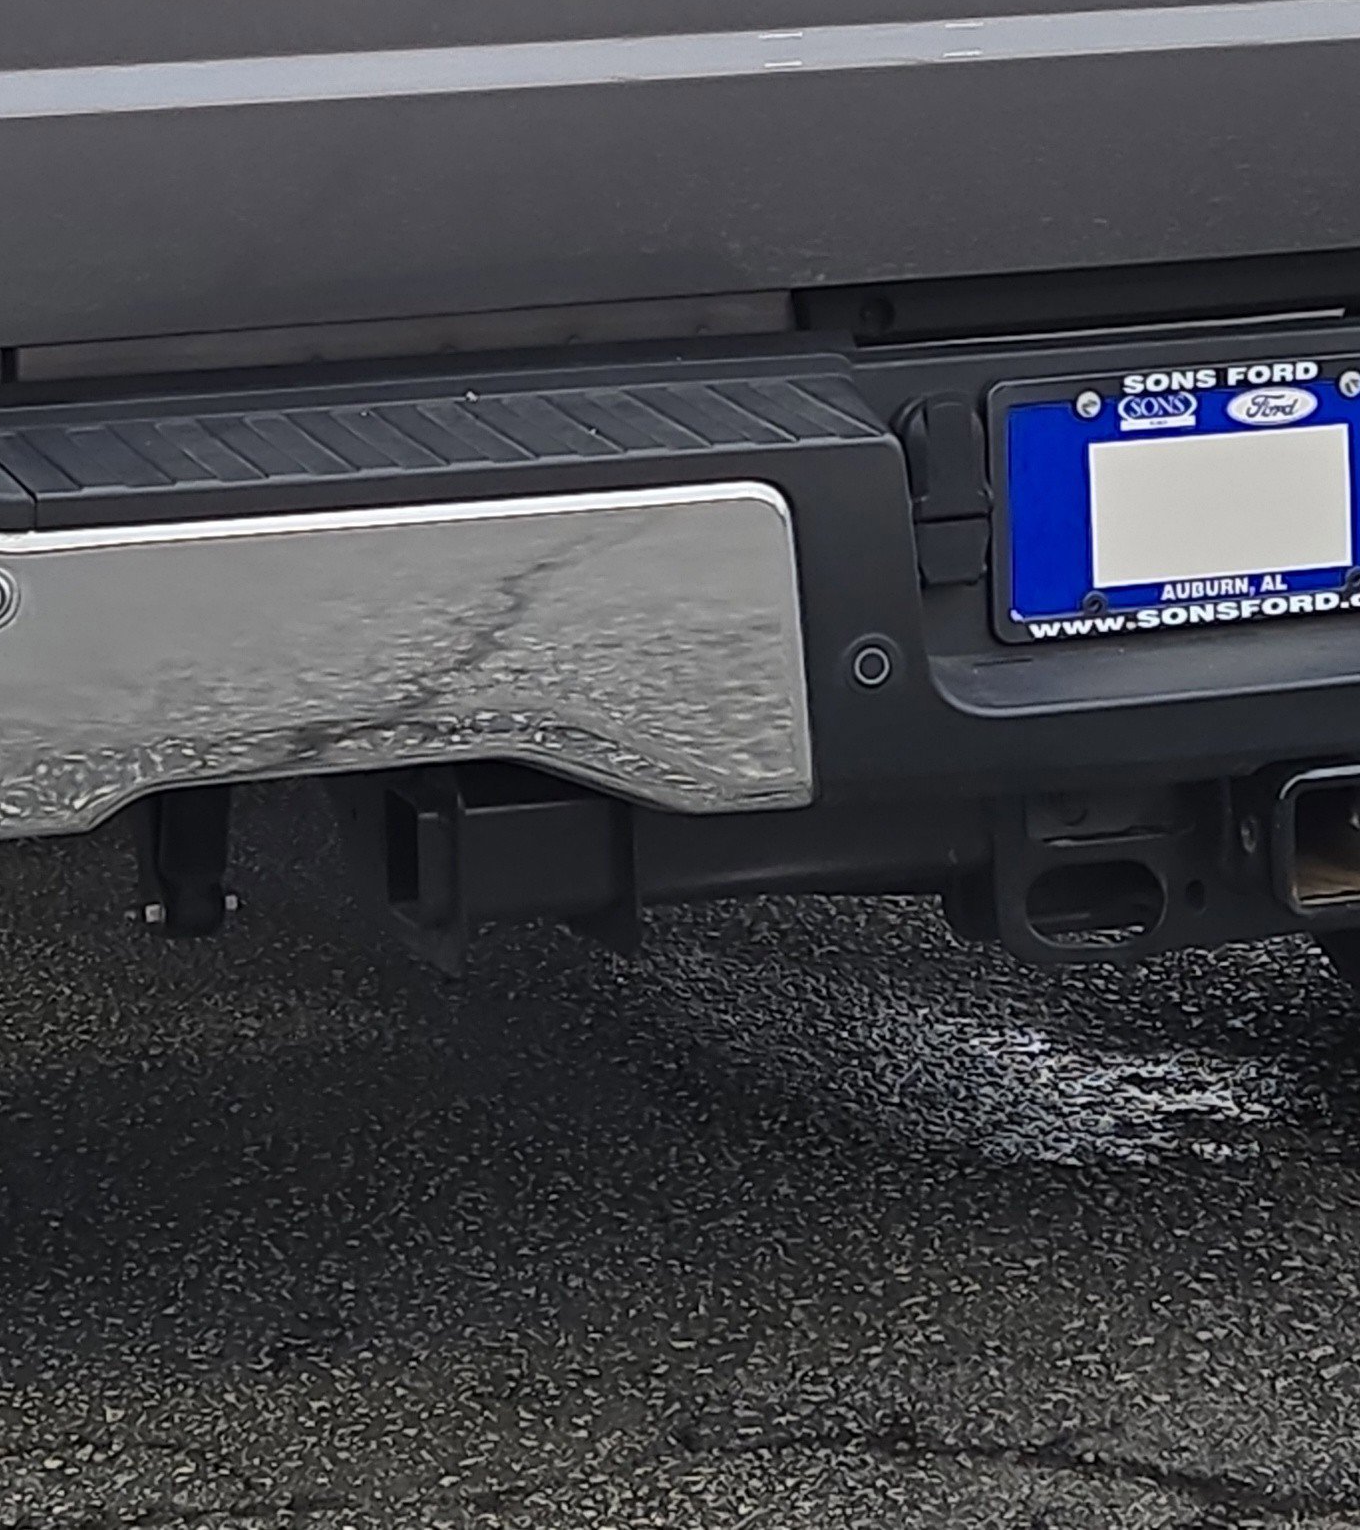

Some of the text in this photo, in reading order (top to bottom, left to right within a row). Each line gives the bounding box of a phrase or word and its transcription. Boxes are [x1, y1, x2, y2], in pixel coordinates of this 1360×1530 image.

[1123, 361, 1319, 394] SONS FORD
[1129, 394, 1186, 418] SONS
[1246, 394, 1299, 419] Ford
[1160, 574, 1288, 601] AUBURN, AL
